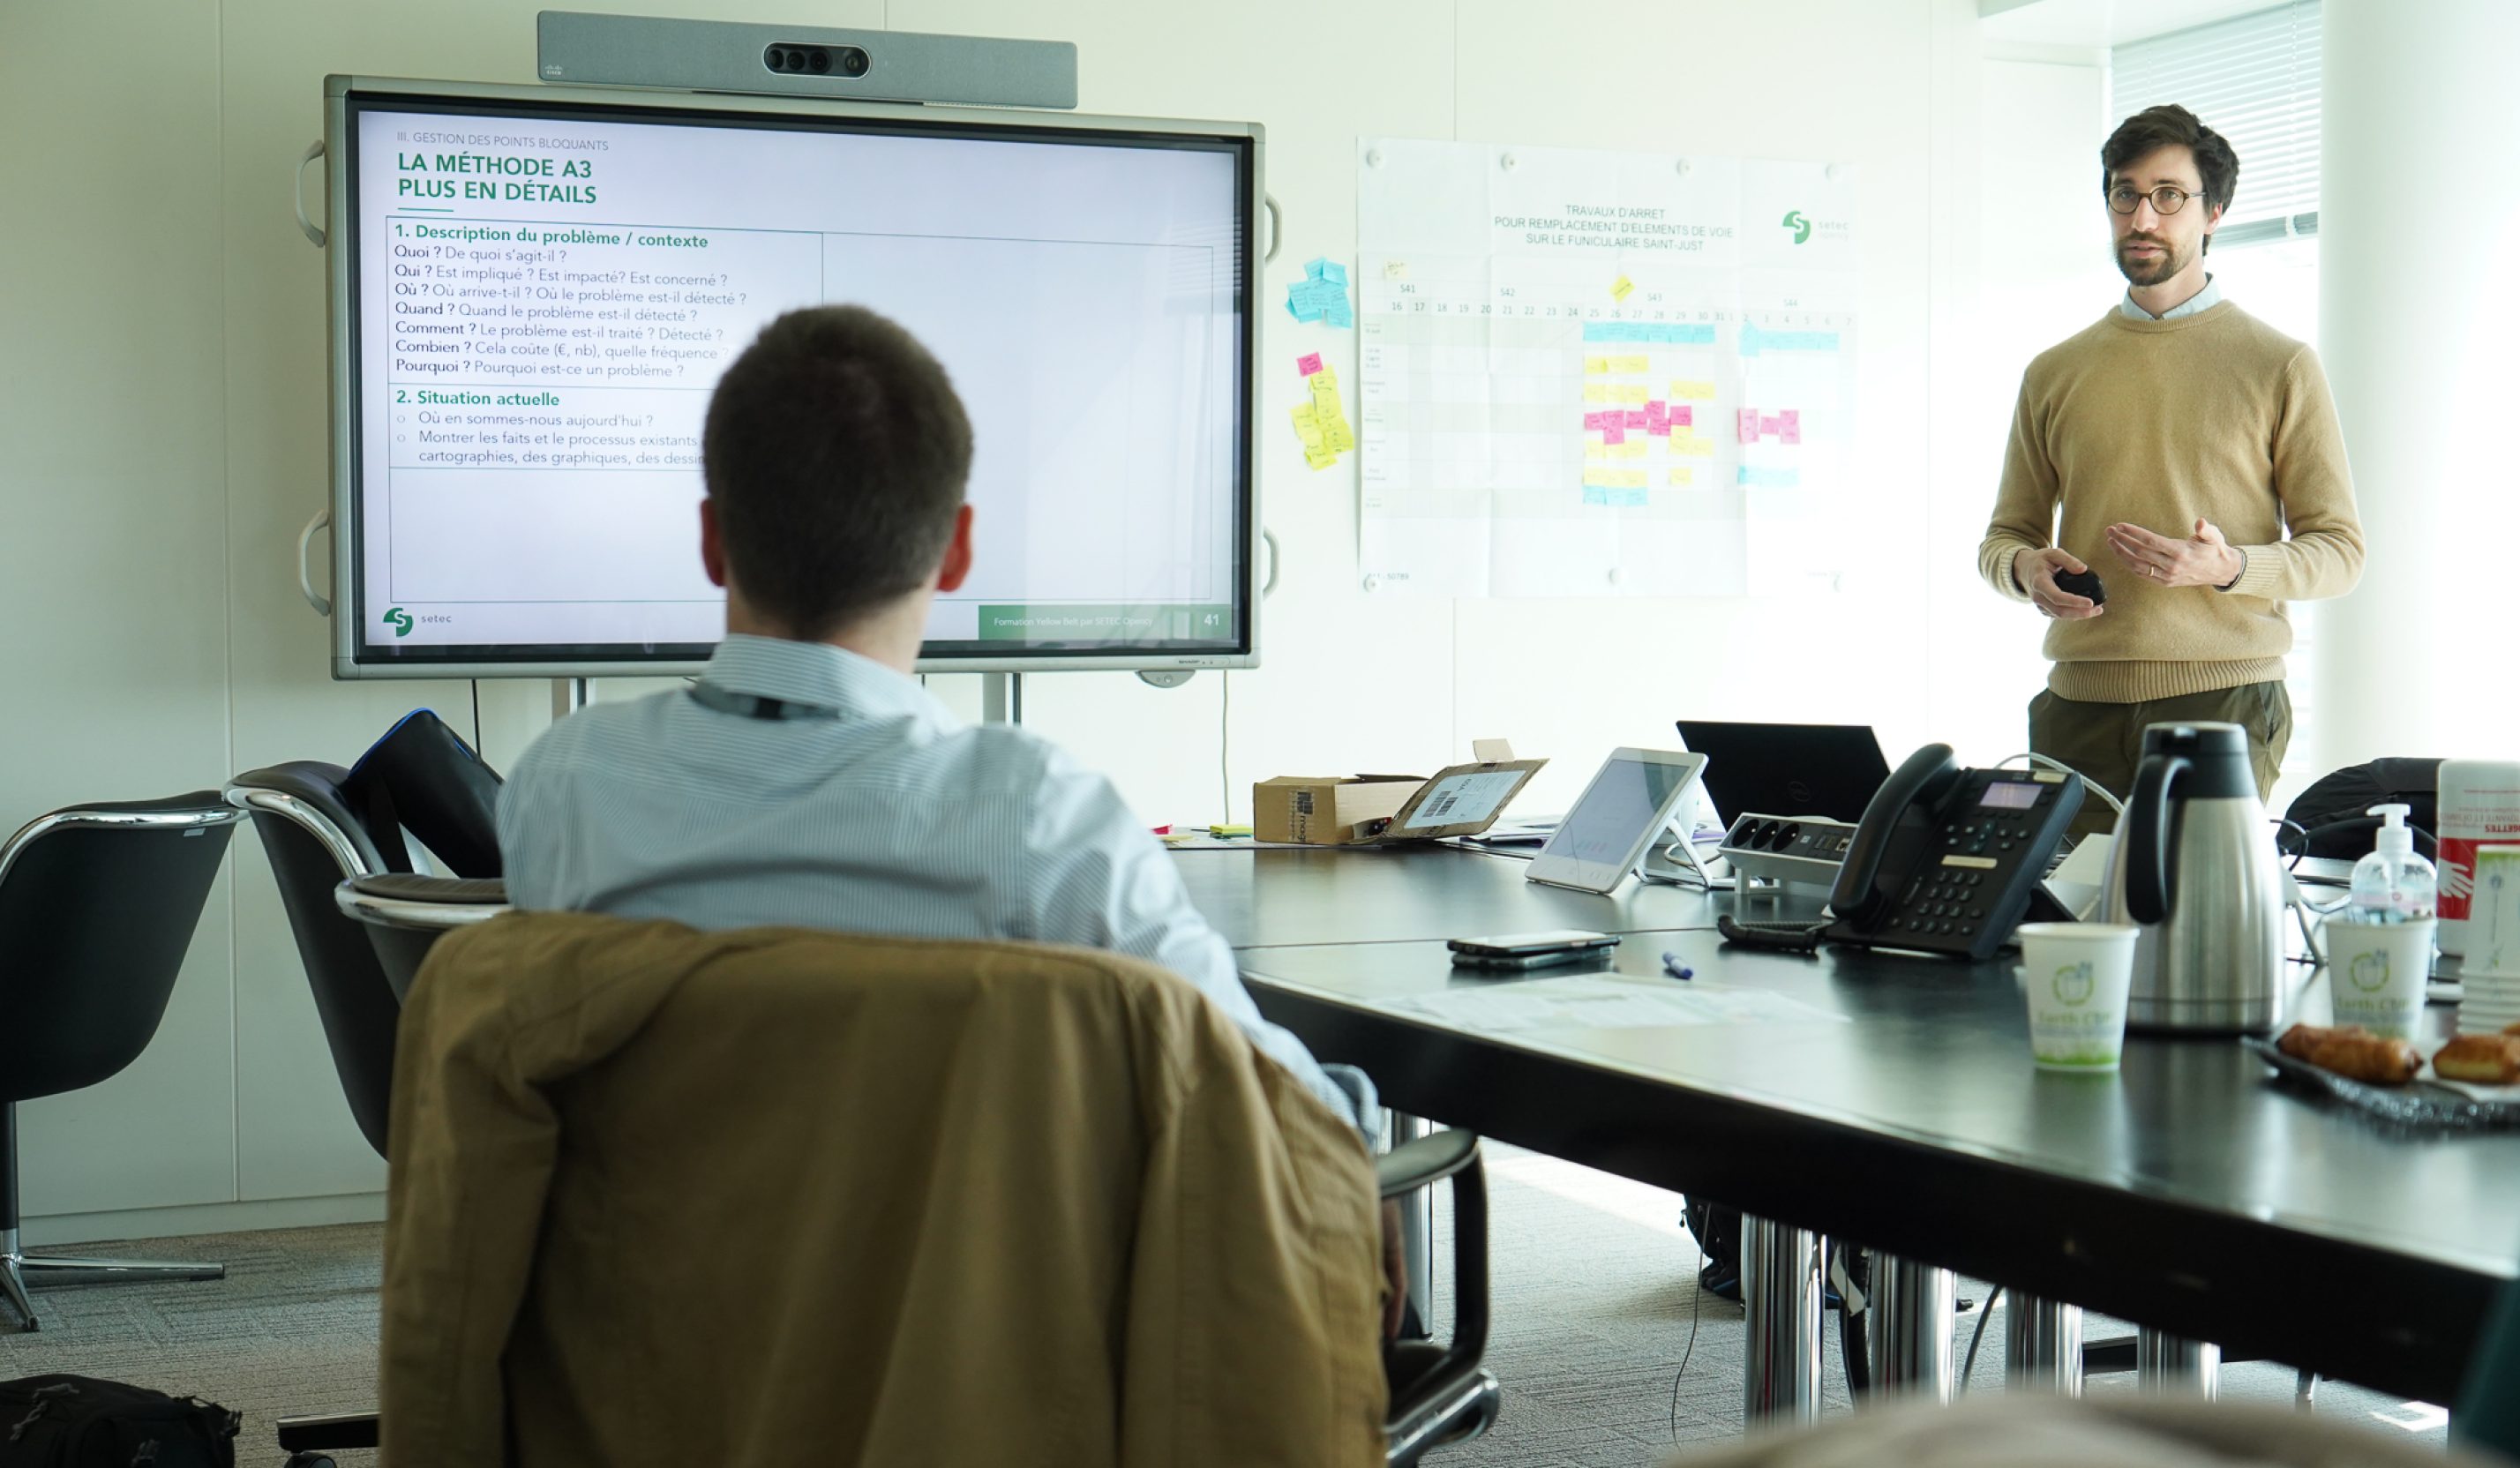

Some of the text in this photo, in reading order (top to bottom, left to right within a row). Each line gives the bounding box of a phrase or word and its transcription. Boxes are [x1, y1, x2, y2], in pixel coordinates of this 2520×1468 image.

[395, 131, 609, 151] III. GESTION DES POINTS BLOQUANTS
[398, 151, 592, 179] LA MÉTHODE A3
[398, 177, 596, 204] PLUS EN DÉTAILS
[1564, 204, 1666, 220] TRAVAUX D'ARRET
[394, 223, 709, 248] 1. Description du problème / contexte
[1494, 215, 1733, 238] POUR REMPLACEMENT D'ELEMENTS DE VOIE
[1524, 233, 1704, 251] SUR LE FUNICULAIRE SAINT-JUST
[394, 243, 430, 258] Quoi
[433, 244, 441, 258] ?
[445, 245, 466, 259] De
[469, 247, 500, 263] quoi
[557, 249, 566, 263] ?
[394, 263, 727, 287] Qui ? Est impliqué ? Est impacté? Est concerné ?
[394, 281, 746, 305] Où ? Où arrive-t-il ? Où le problème est-il détecté ?
[394, 301, 698, 322] Quand ? Quand le problème est-il détecté ?
[1391, 301, 1402, 311] 16
[1414, 302, 1425, 311] 17
[1436, 303, 1447, 311] 18
[1459, 303, 1469, 313] 19
[1481, 303, 1491, 314] 20
[1502, 304, 1512, 315] 21
[1524, 305, 1534, 315] 22
[1546, 306, 1556, 316] 23
[1568, 306, 1578, 317] 24
[1588, 308, 1600, 317] 25
[1610, 309, 1621, 318] 26
[1631, 309, 1643, 318] 27
[1654, 310, 1664, 319] 28
[1675, 311, 1686, 319] 29
[1698, 311, 1708, 320] 30
[1714, 311, 1724, 321] 31
[395, 320, 724, 341] Comment ? Le problème est-il traité ? Détecté ?
[395, 339, 460, 353] Combien
[463, 341, 471, 354] ?
[474, 341, 506, 355] Cela
[510, 341, 550, 356] coûte
[604, 344, 647, 361] quelle
[649, 345, 718, 362] fréquence
[395, 357, 685, 379] Pourquoi ? Pourquoi est-ce un problème ?
[395, 389, 559, 406] 2. Situation actuelle
[417, 410, 654, 430] Où en sommes-nous aujourd'hui ?
[418, 430, 698, 449] Montrer les faits et le processus existants
[418, 449, 518, 466] cartographies,
[521, 449, 547, 463] des
[551, 450, 632, 468] graphiques,
[635, 451, 660, 464] des
[1204, 614, 1219, 626] 41
